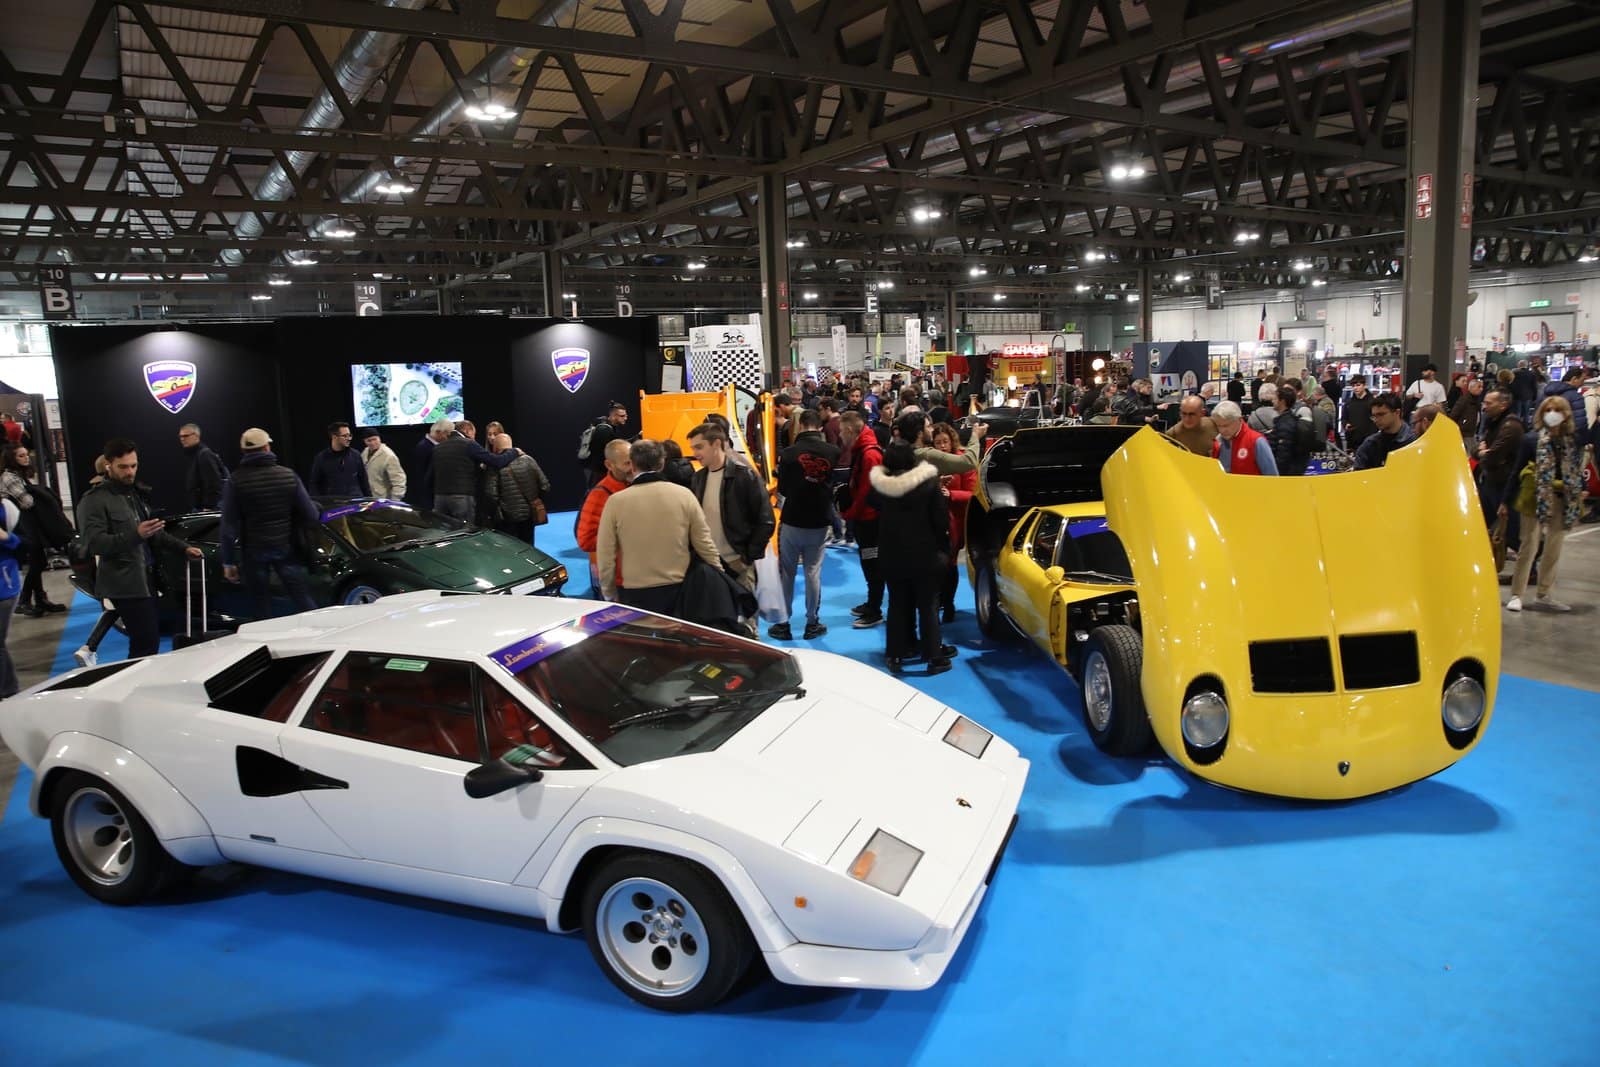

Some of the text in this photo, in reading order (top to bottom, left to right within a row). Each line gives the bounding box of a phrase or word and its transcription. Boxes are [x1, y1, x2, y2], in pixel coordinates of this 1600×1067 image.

[48, 269, 64, 280] 10
[363, 286, 376, 295] 10
[620, 285, 631, 294] 10
[1209, 286, 1220, 303] F
[45, 288, 71, 312] B
[867, 297, 878, 313] E
[618, 300, 633, 317] D
[1296, 303, 1305, 316] H
[1374, 301, 1380, 313] K
[927, 325, 937, 336] G
[1004, 345, 1048, 355] GARAGE
[1009, 361, 1043, 373] PIRELLI
